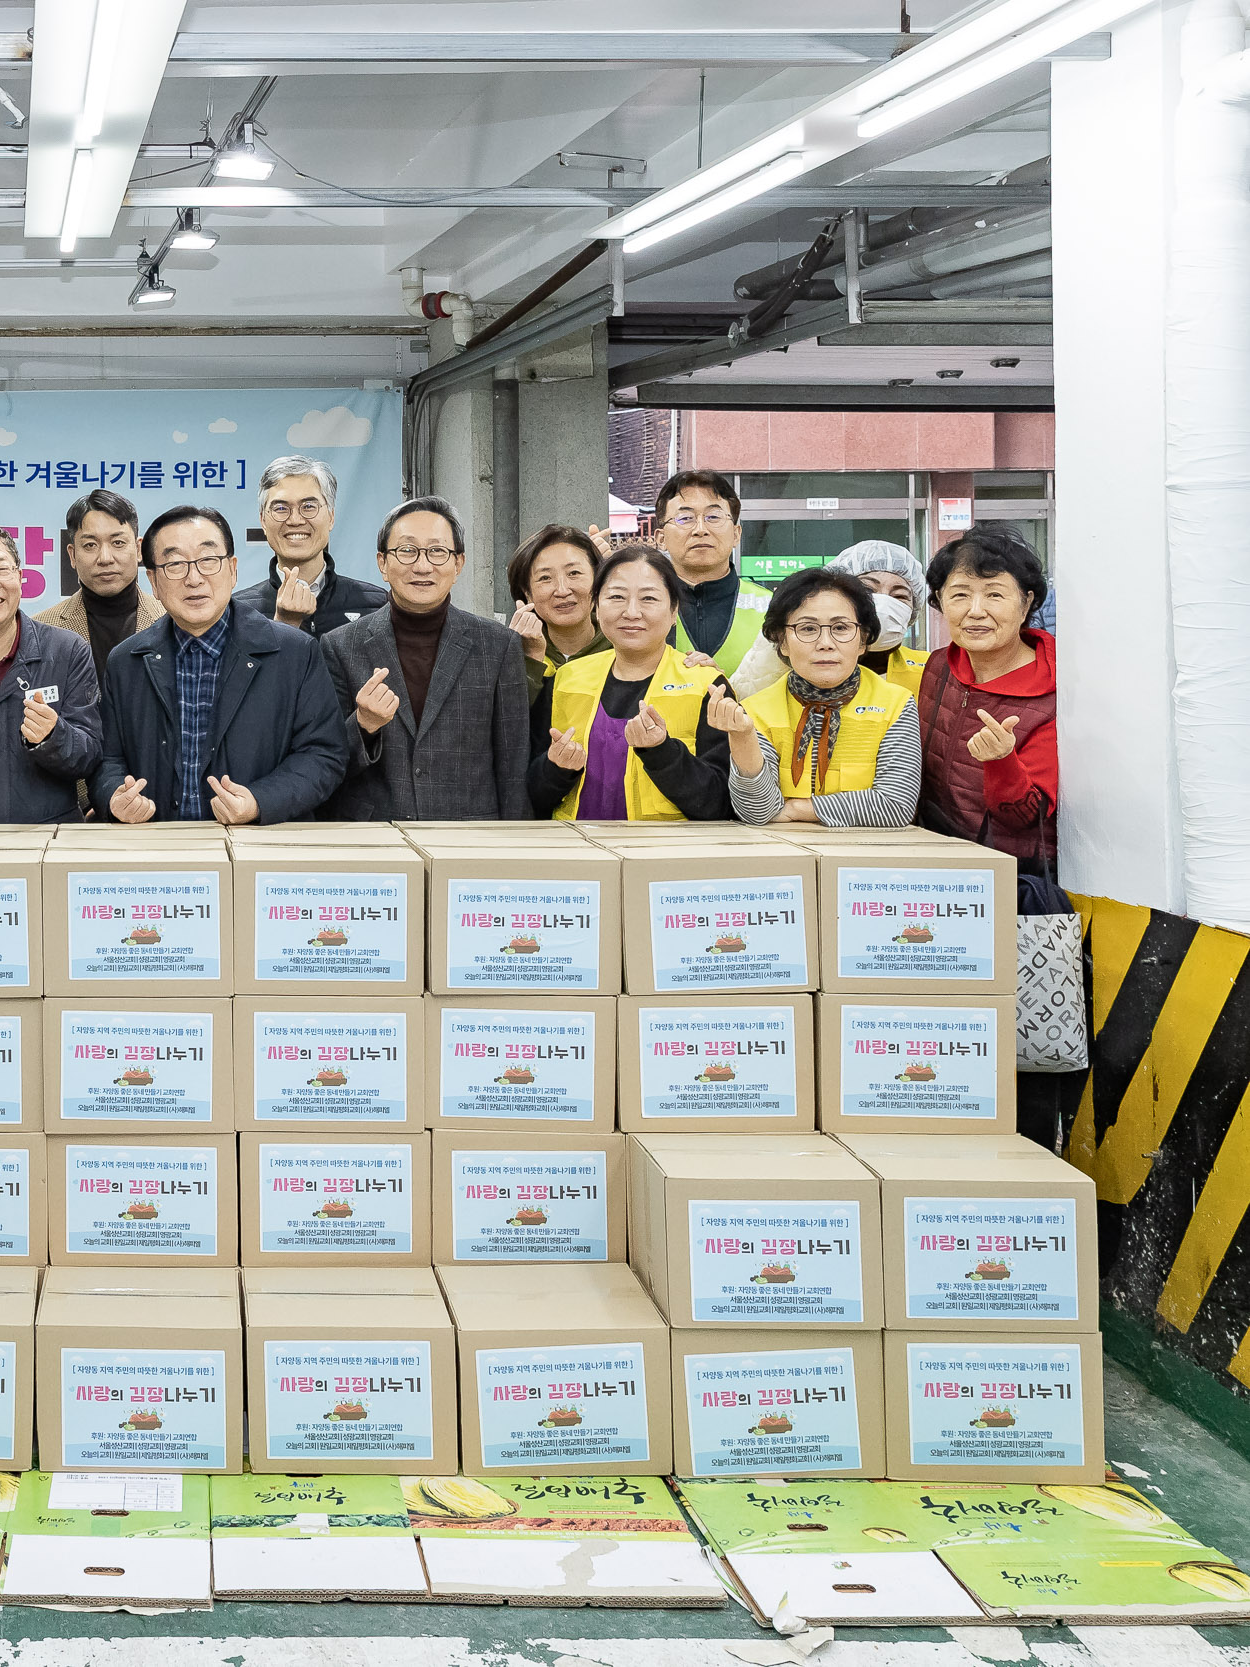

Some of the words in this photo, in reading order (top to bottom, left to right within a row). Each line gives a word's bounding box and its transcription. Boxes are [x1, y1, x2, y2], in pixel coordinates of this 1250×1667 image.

[25, 459, 165, 489] 겨울나기를
[172, 459, 228, 489] 위한
[82, 886, 102, 895] 자양동
[103, 886, 116, 895] 지역
[117, 886, 136, 894] 주민의
[137, 886, 157, 894] 따뜻한
[158, 886, 190, 894] 겨울나기를
[191, 885, 205, 894] 위한
[81, 904, 125, 919] 사랑의
[130, 904, 210, 919] 김장나누기
[268, 905, 312, 920] 사랑의
[318, 905, 397, 922] 김장나누기
[851, 901, 896, 917] 사랑의
[902, 902, 984, 918] 김장나누기
[460, 912, 505, 928] 사랑의
[510, 913, 590, 929] 김장나누기
[664, 912, 709, 929] 사랑의
[714, 910, 795, 927] 김장나누기
[654, 1022, 674, 1031] 자양동
[675, 1022, 688, 1031] 지역
[689, 1022, 710, 1031] 주민의
[710, 1021, 731, 1031] 따뜻한
[731, 1021, 764, 1030] 겨울나기를
[766, 1021, 779, 1030] 위한
[267, 1045, 311, 1060] 사랑의
[317, 1045, 397, 1062] 김장나누기
[653, 1041, 698, 1056] 사랑의
[703, 1040, 785, 1056] 김장나누기
[920, 1213, 943, 1223] 자양동
[944, 1213, 959, 1223] 지역
[960, 1214, 982, 1224] 주민의
[983, 1214, 1006, 1224] 따뜻한
[1007, 1214, 1043, 1224] 겨울나기를
[1044, 1215, 1059, 1225] 위한
[704, 1237, 754, 1254] 사랑의
[760, 1238, 850, 1256] 김장나누기
[919, 1234, 969, 1251] 사랑의
[975, 1235, 1066, 1252] 김장나누기
[280, 1355, 302, 1365] 자양동
[303, 1356, 317, 1365] 지역
[318, 1356, 340, 1365] 주민의
[341, 1356, 362, 1366] 따뜻한
[363, 1356, 399, 1366] 겨울나기를
[400, 1356, 415, 1366] 위한
[279, 1376, 327, 1392] 사랑의
[333, 1376, 421, 1393] 김장나누기
[492, 1383, 541, 1401] 사랑의
[547, 1380, 635, 1399] 김장나누기
[923, 1381, 974, 1398] 사랑의
[980, 1382, 1071, 1400] 김장나누기
[75, 1385, 123, 1402] 사랑의
[129, 1386, 215, 1403] 김장나누기
[701, 1389, 751, 1408] 사랑의
[756, 1386, 846, 1406] 김장나누기
